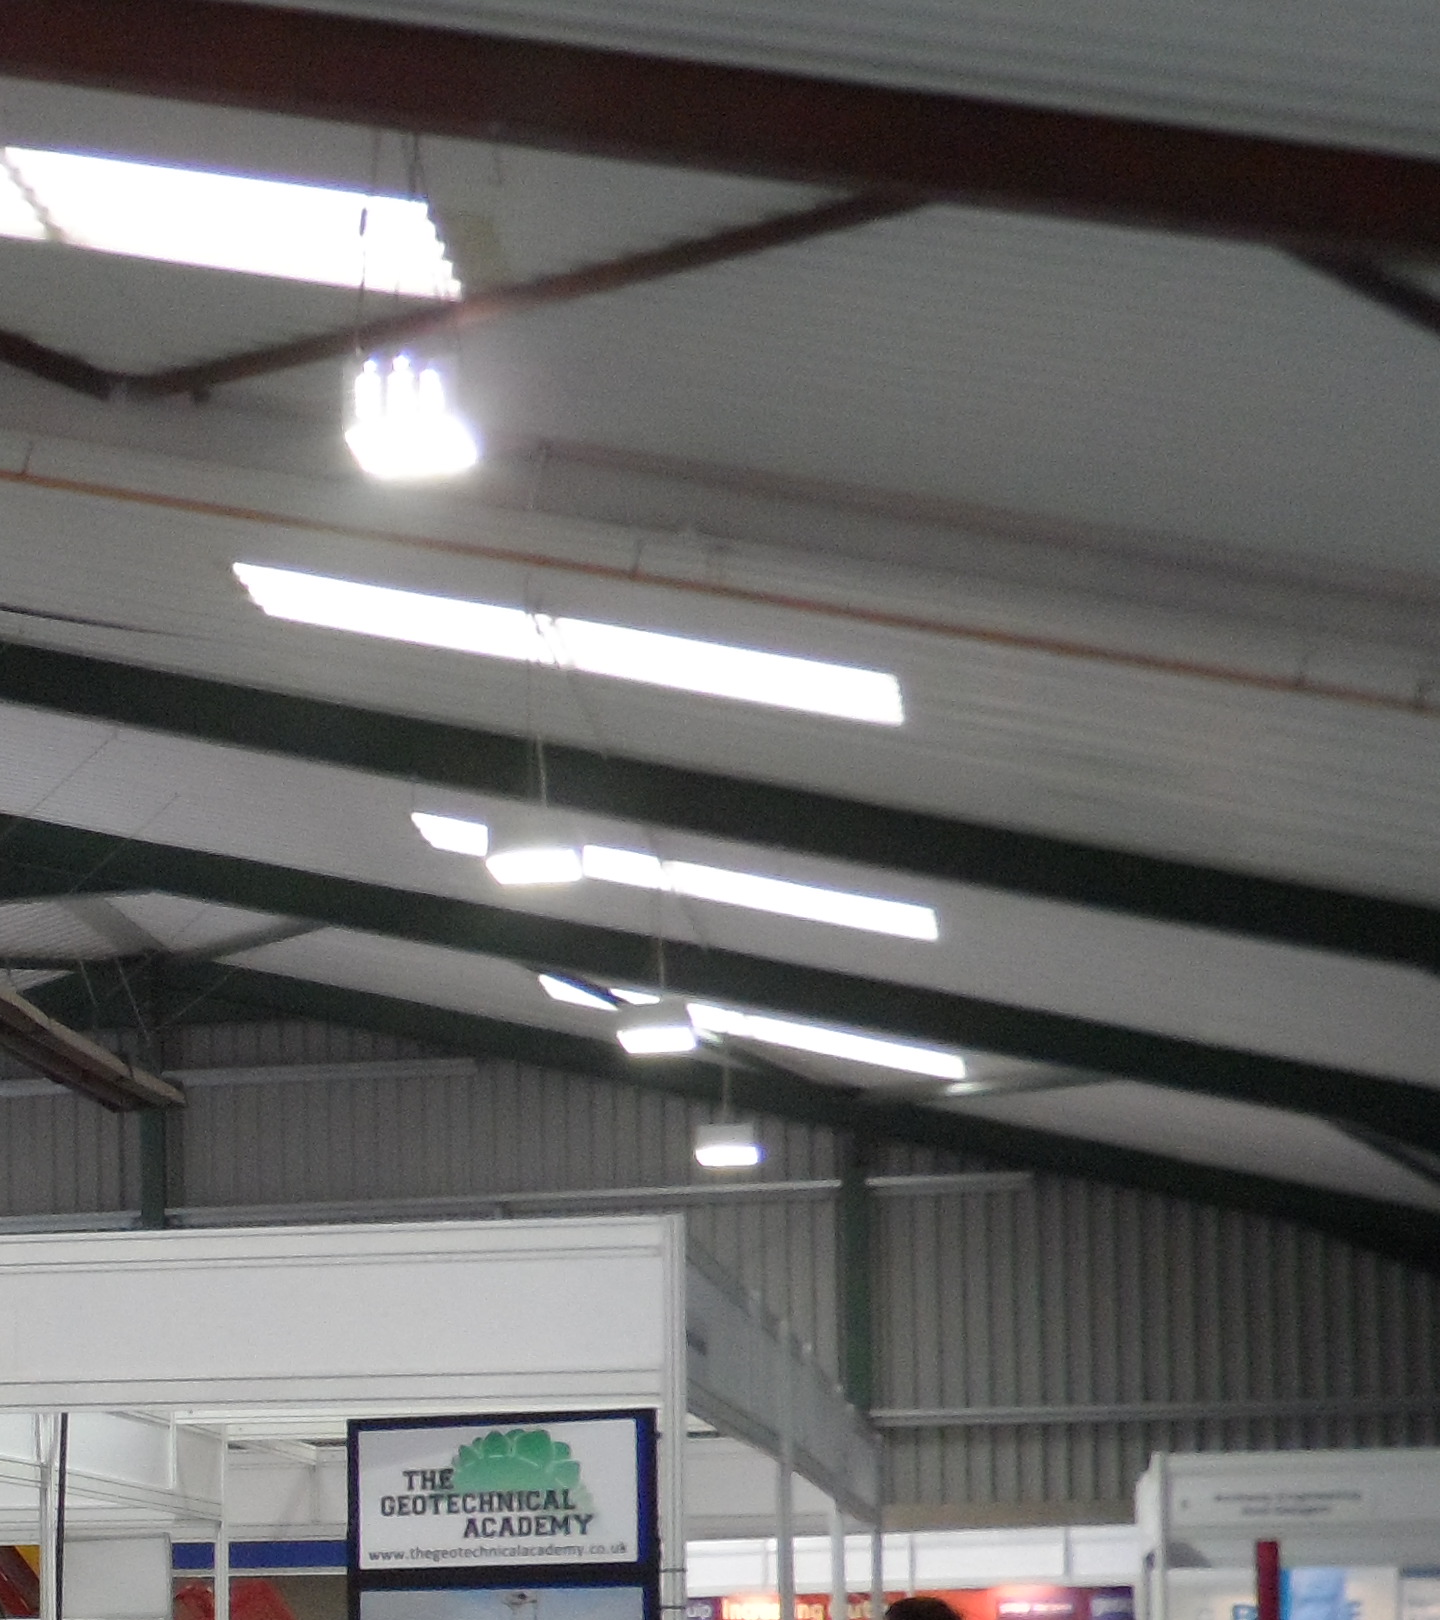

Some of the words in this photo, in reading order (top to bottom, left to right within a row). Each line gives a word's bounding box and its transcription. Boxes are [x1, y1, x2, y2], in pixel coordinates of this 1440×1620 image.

[403, 1468, 455, 1492] THE
[381, 1490, 577, 1517] GEOTECHNICAL
[463, 1513, 595, 1539] ACADEMY
[368, 1541, 628, 1563] www.thegeotechnicalacademy.co.uk
